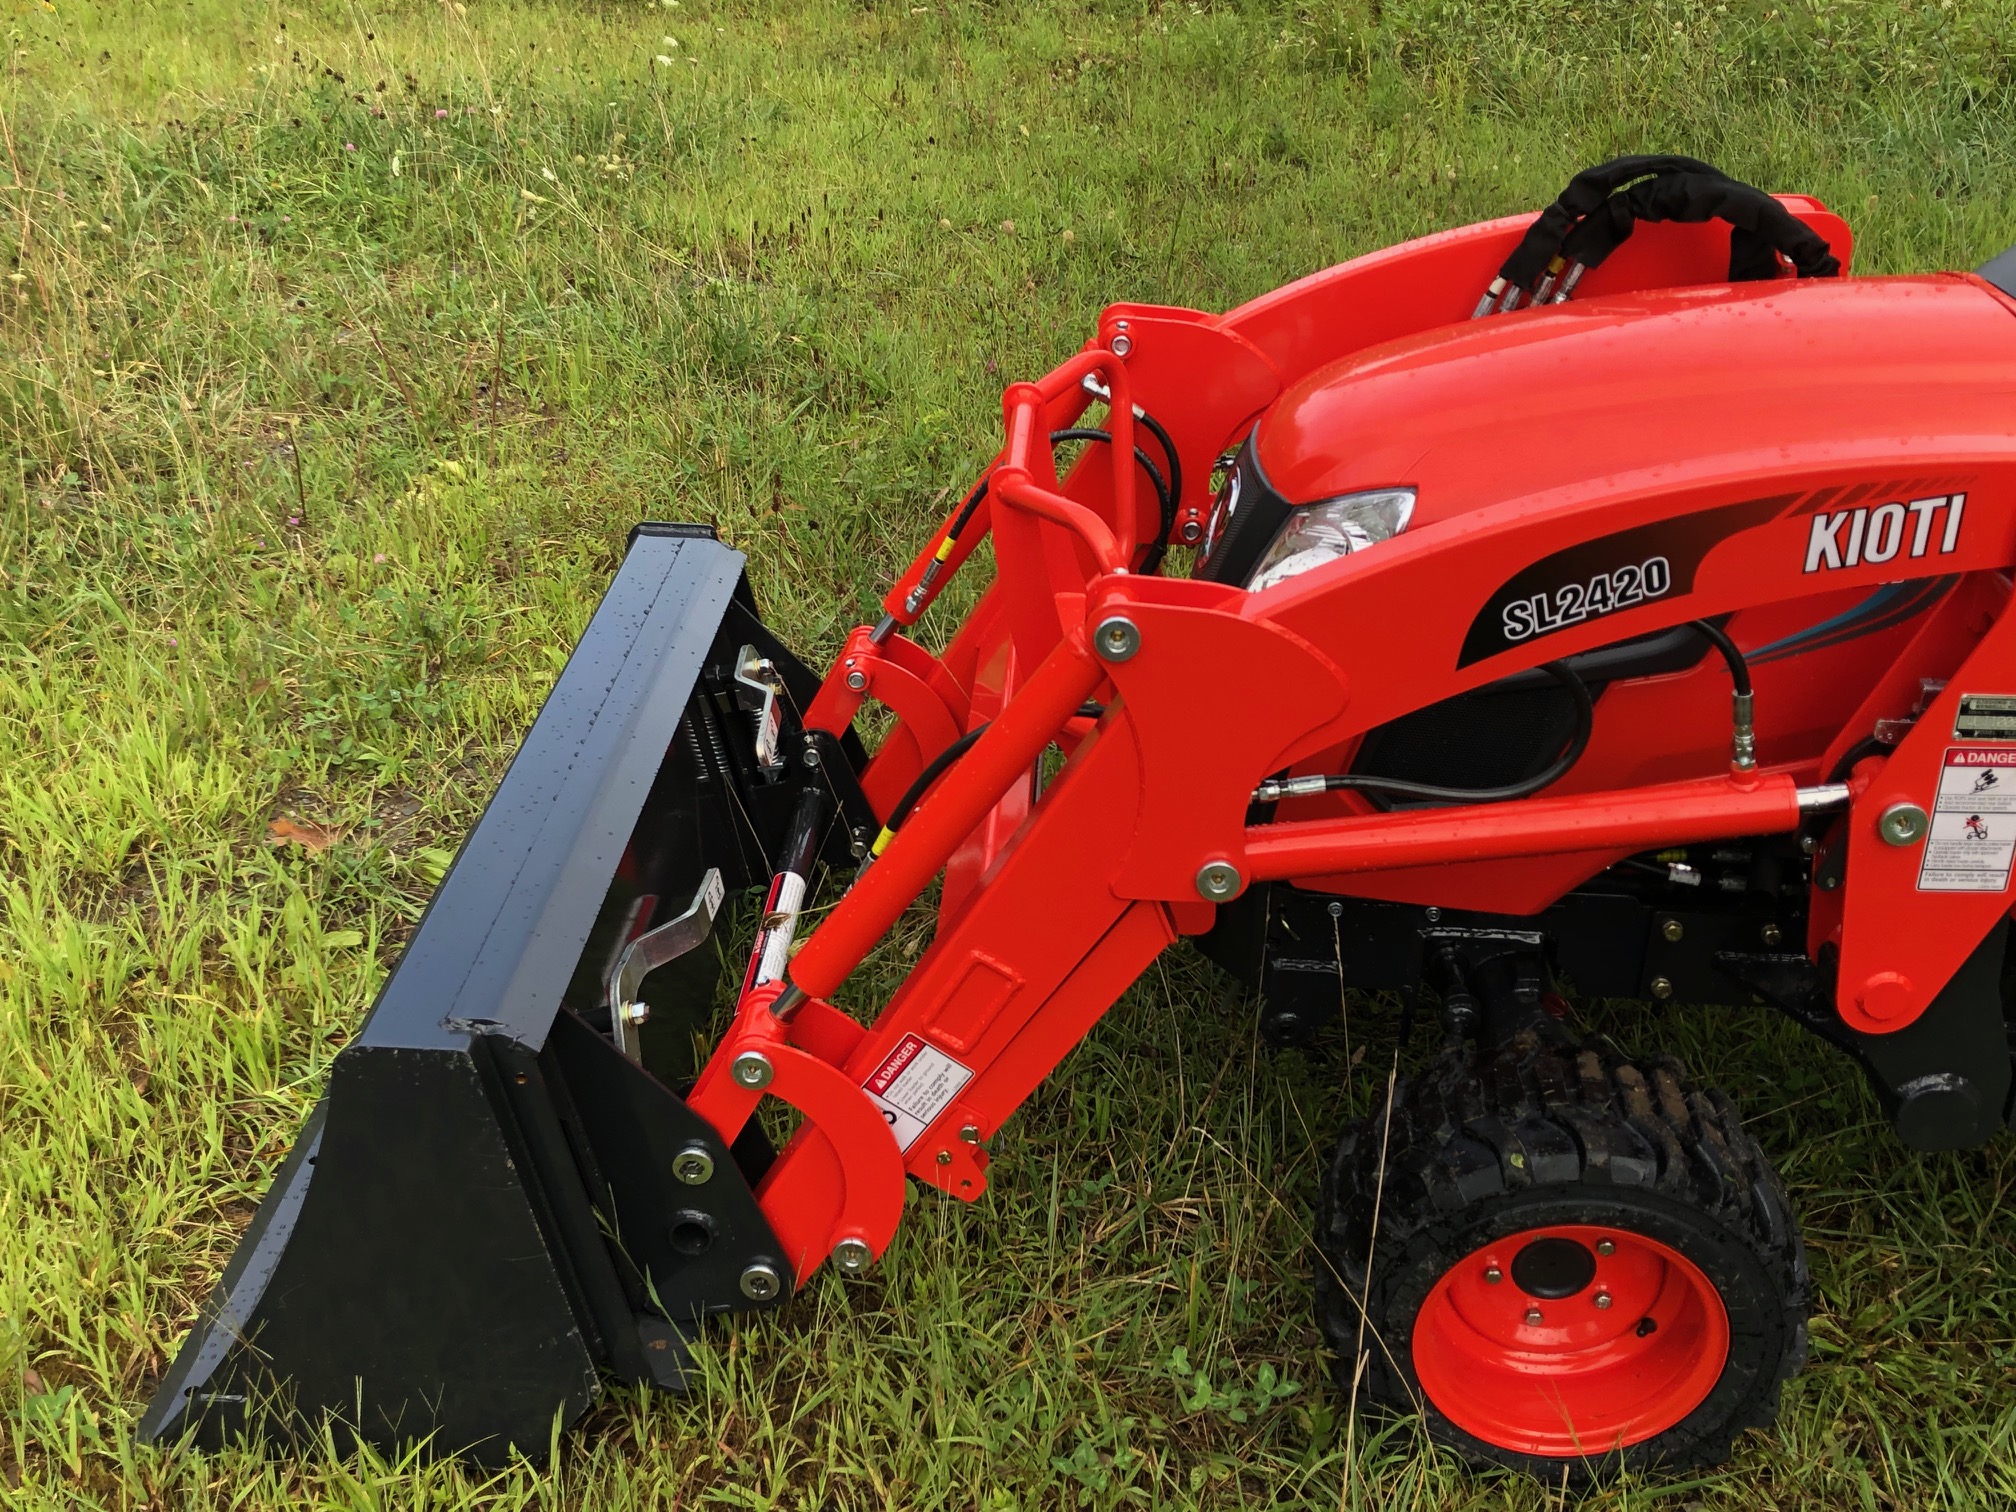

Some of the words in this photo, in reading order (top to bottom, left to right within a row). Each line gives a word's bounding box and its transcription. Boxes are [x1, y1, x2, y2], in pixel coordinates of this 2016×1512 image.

[1803, 492, 1967, 573] KIOTI
[1502, 556, 1671, 640] SL2420
[879, 1040, 918, 1081] DANGER
